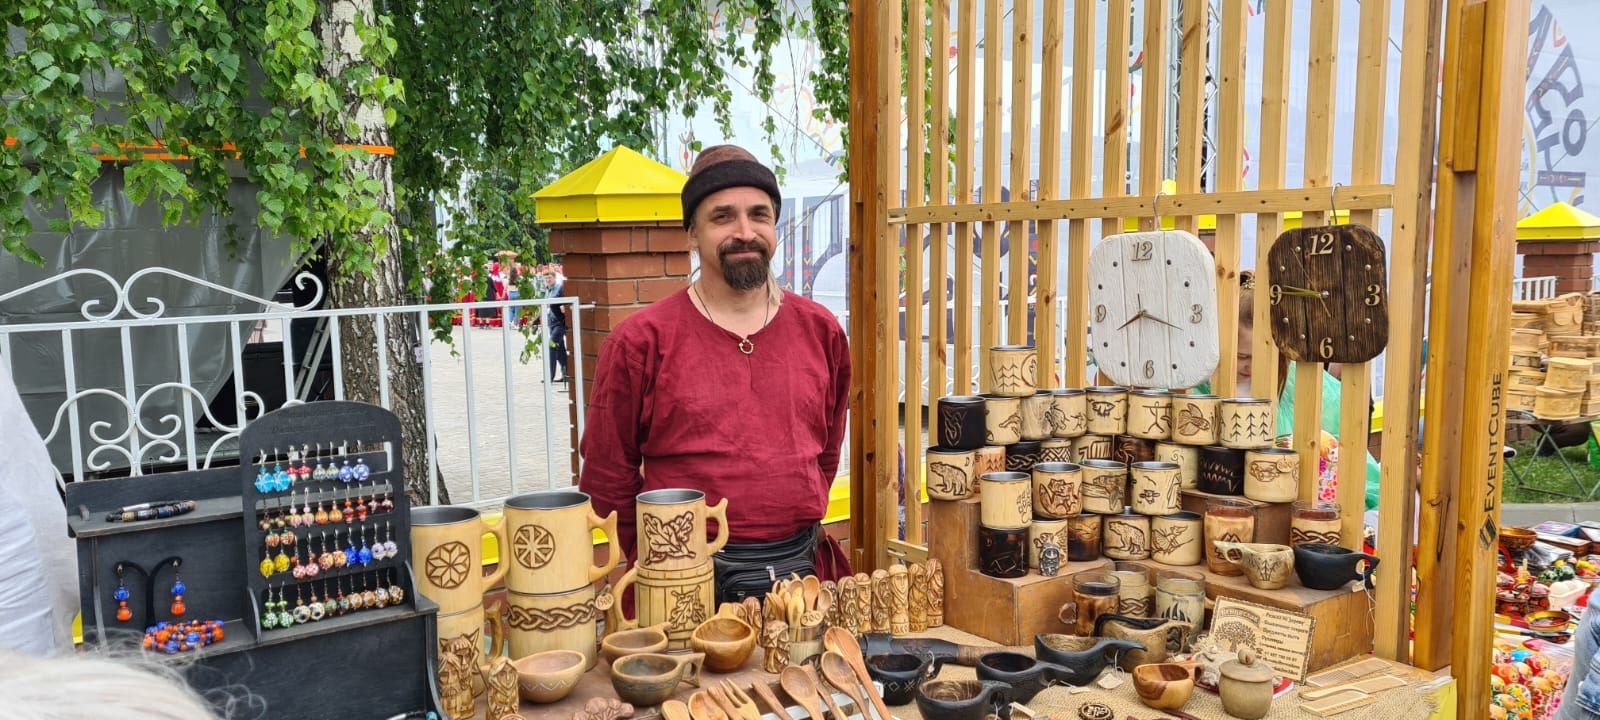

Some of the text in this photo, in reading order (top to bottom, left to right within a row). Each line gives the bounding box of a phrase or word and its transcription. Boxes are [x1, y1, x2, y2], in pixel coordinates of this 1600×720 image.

[1131, 240, 1153, 262] 12
[1309, 232, 1334, 256] 12
[1269, 285, 1283, 306] 9
[1365, 285, 1381, 306] 3
[1095, 304, 1107, 323] 9
[1190, 303, 1203, 324] 3
[1319, 337, 1334, 359] 6
[1143, 359, 1155, 379] 6
